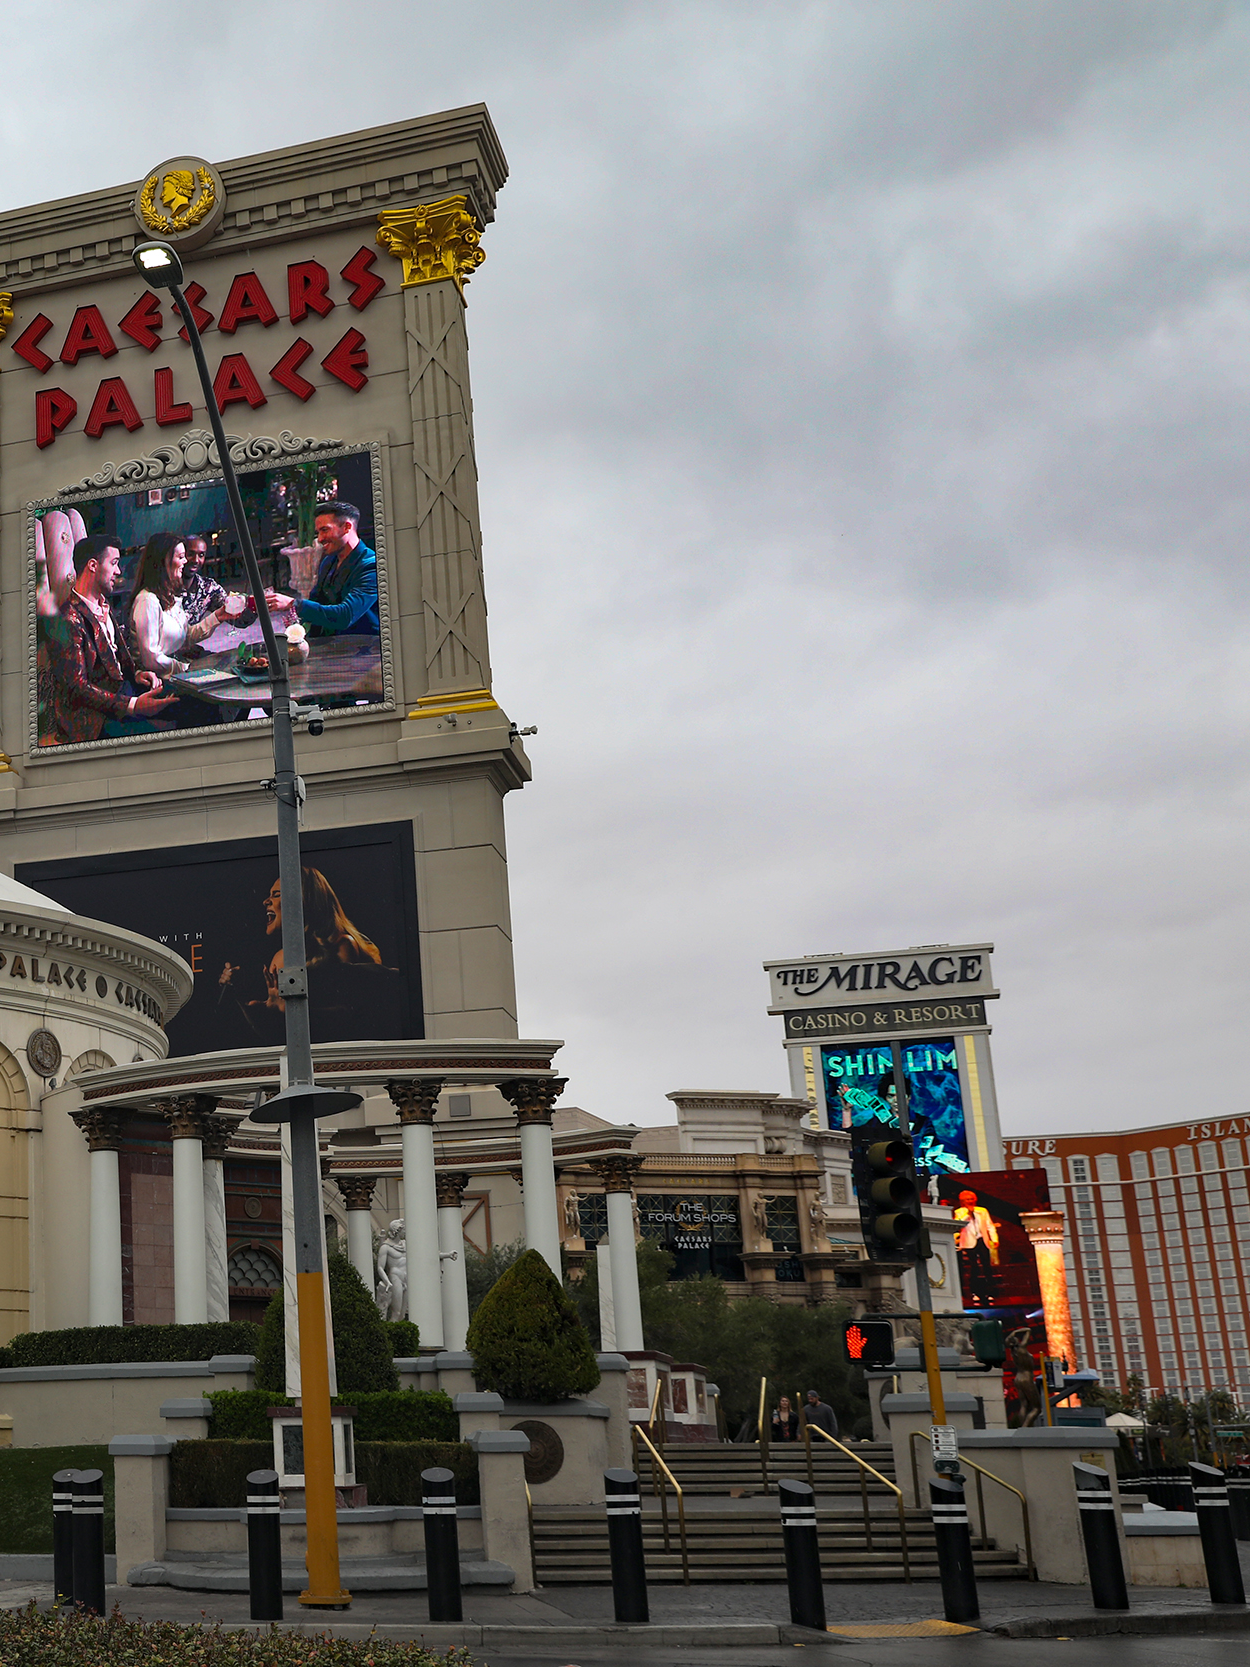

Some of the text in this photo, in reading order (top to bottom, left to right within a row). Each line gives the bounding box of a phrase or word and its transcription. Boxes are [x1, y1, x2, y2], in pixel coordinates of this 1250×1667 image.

[10, 245, 386, 374] CAESARS
[35, 327, 369, 450] PALACE
[159, 932, 203, 943] WITH
[776, 954, 983, 997] THE MIRAGE
[789, 1003, 981, 1031] CASINO & RESORT
[828, 1048, 959, 1078] SHIN LIM
[648, 1213, 736, 1223] FORUM SHOPS
[679, 1202, 704, 1211] THE
